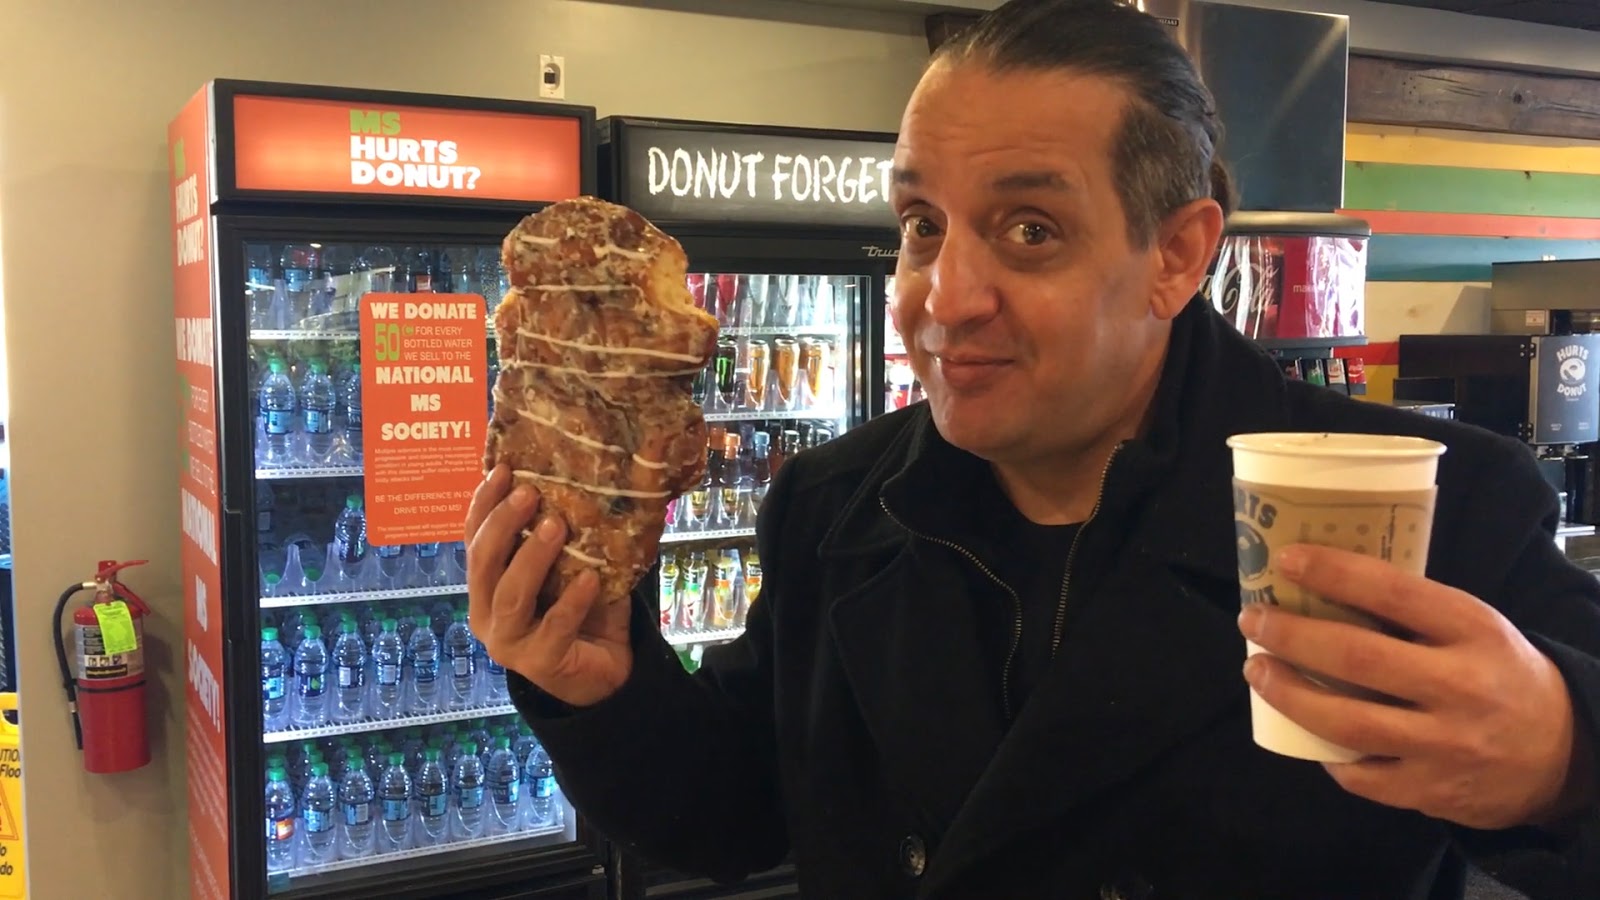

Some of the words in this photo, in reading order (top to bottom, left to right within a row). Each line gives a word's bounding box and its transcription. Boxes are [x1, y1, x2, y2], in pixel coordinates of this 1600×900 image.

[350, 109, 401, 135] MS
[350, 135, 458, 164] HURTS
[351, 161, 481, 190] DONUT?
[648, 146, 764, 199] DONUT
[771, 153, 895, 203] FORGET
[370, 303, 399, 319] WE
[405, 303, 477, 319] DONATE
[415, 326, 433, 336] FOR
[435, 326, 462, 336] EVERY
[403, 339, 442, 349] BOTTLED
[444, 339, 473, 348] WATER
[1556, 344, 1590, 362] HURTS
[404, 352, 418, 361] WE
[420, 352, 440, 361] SELL
[442, 352, 453, 361] TO
[455, 352, 471, 361] THE
[375, 366, 474, 384] NATIONAL
[1556, 382, 1588, 397] DONUT
[410, 394, 441, 412] MS
[381, 421, 471, 441] SOCIETY!
[387, 494, 403, 502] THE
[394, 506, 417, 515] DRIVE
[419, 505, 430, 513] TO
